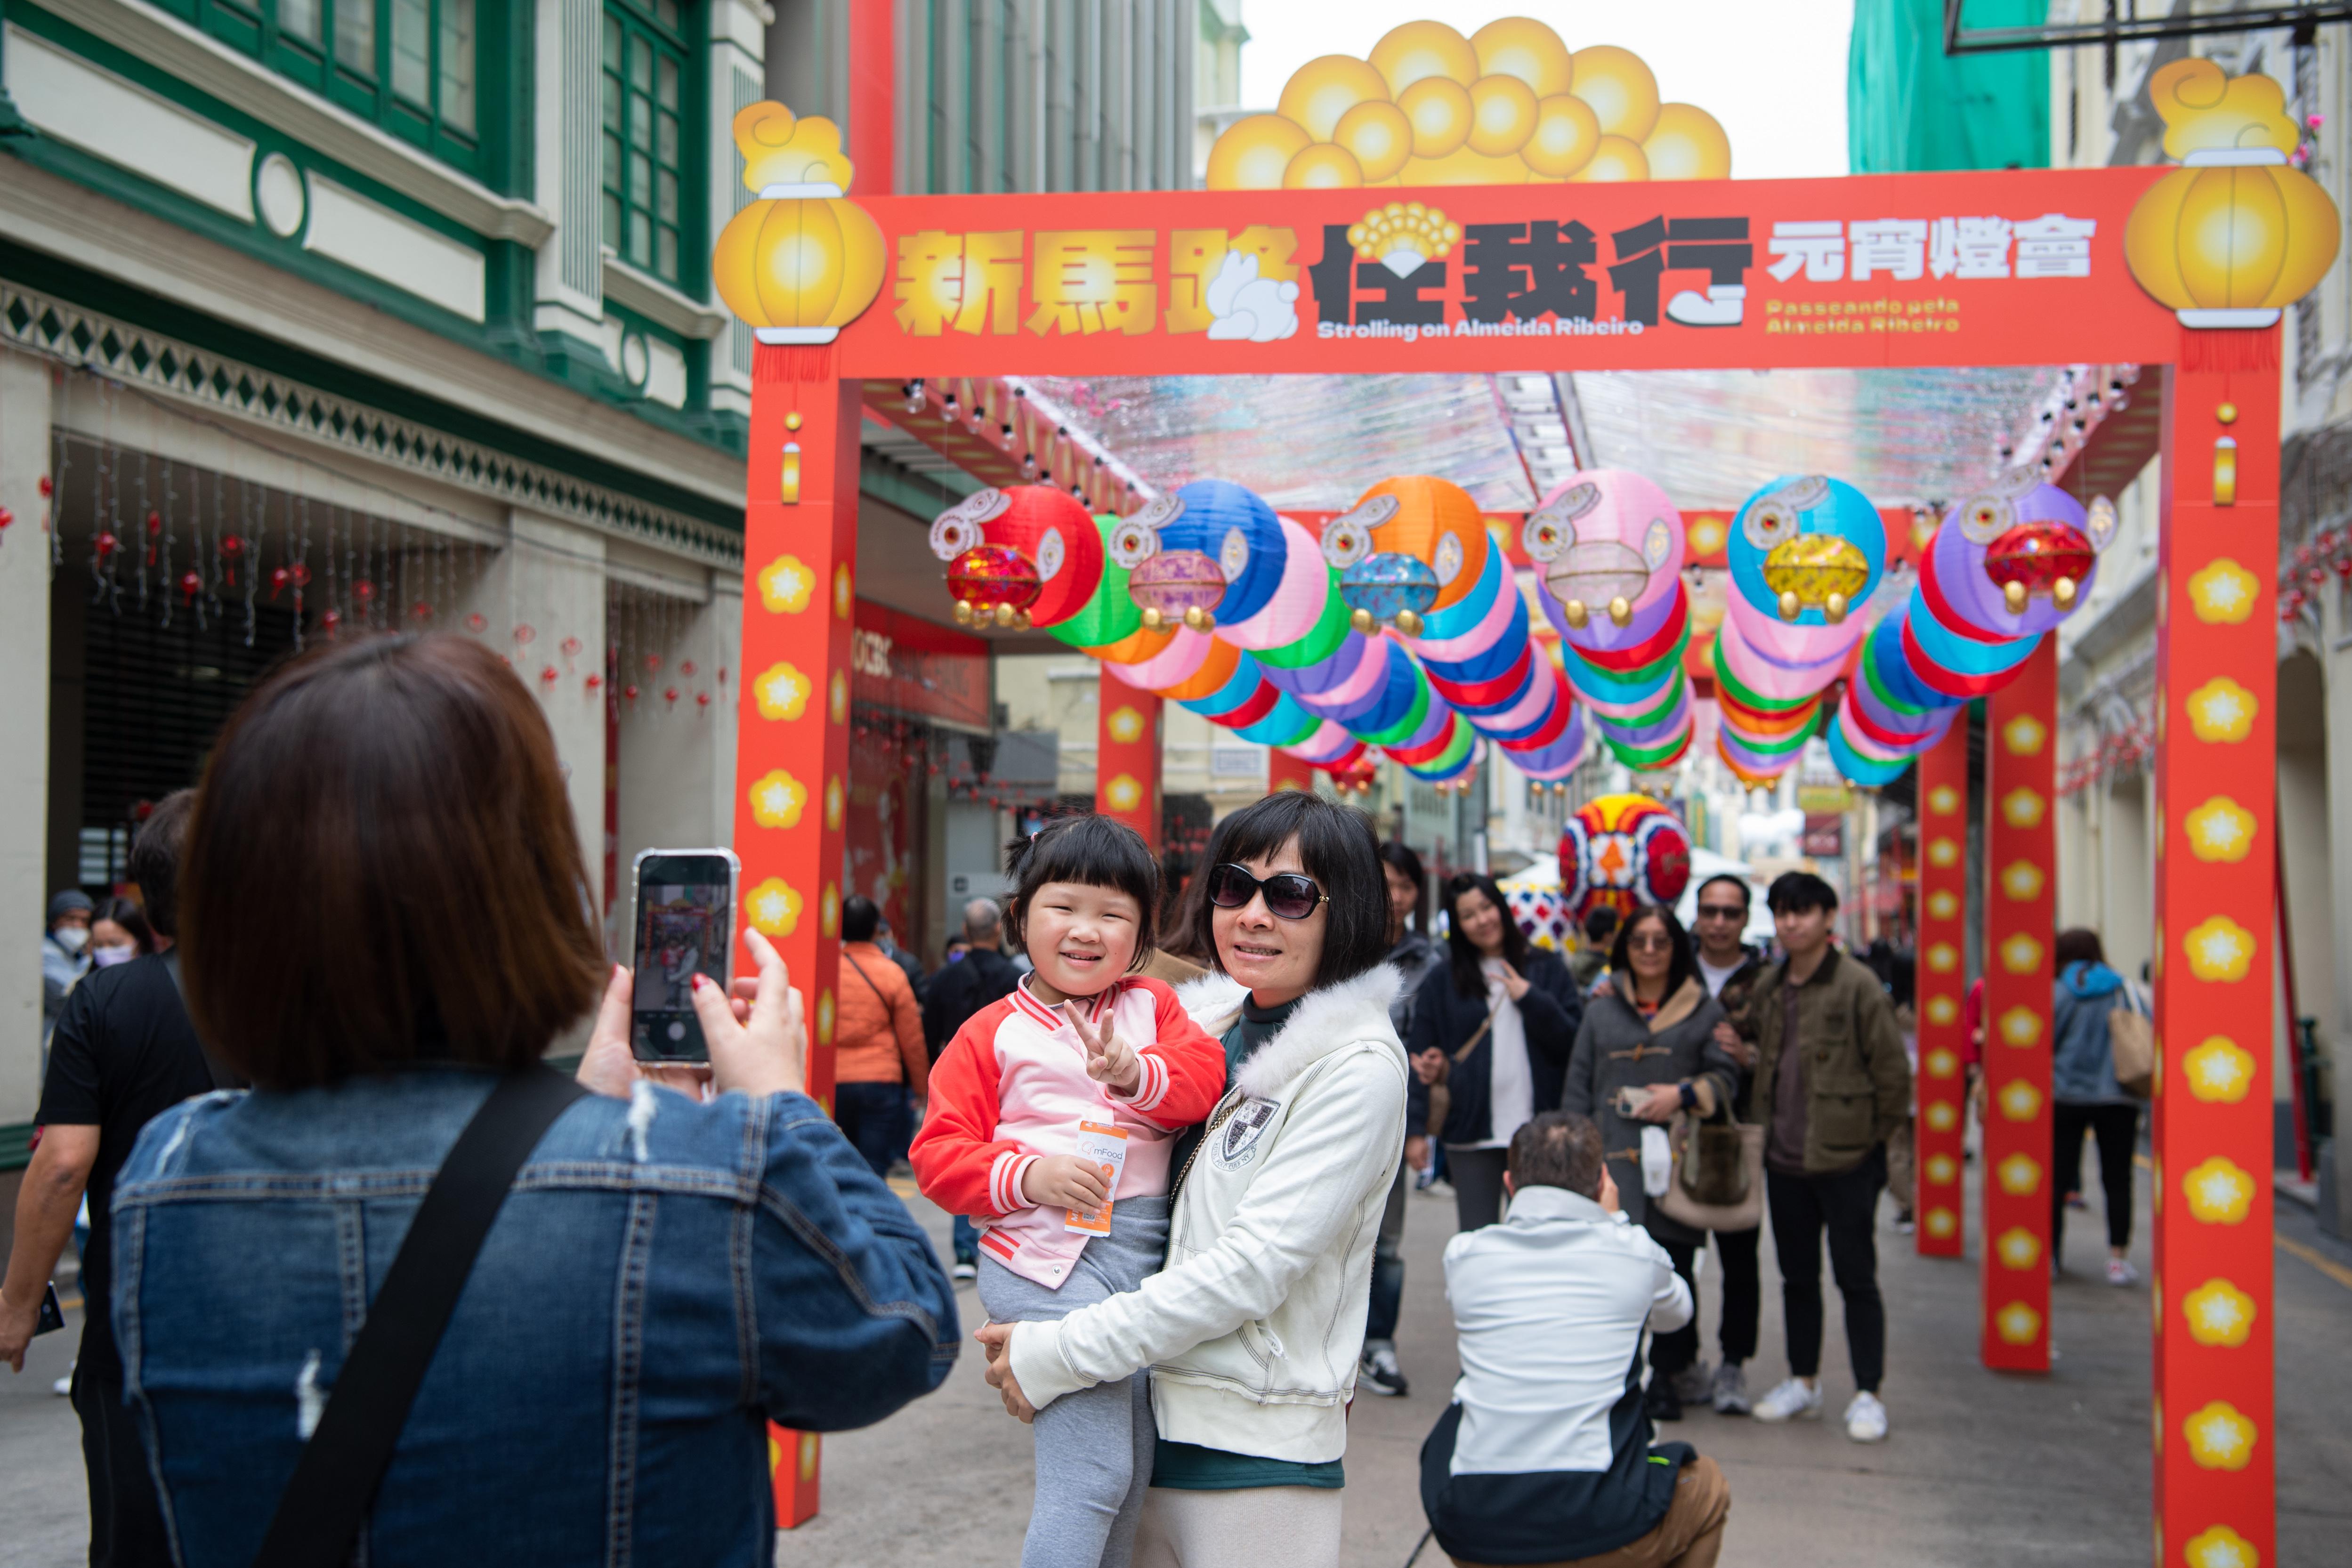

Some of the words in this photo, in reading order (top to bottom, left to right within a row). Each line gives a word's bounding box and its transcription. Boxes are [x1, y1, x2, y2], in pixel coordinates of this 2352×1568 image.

[1766, 213, 2097, 283] 元宵燈會
[1765, 296, 1903, 316] Passeando
[1906, 295, 1960, 317] pela
[1317, 318, 1418, 342] Strolling
[1421, 323, 1450, 337] on
[1453, 317, 1552, 338] Almeida
[1554, 315, 1644, 336] Ribeiro
[1765, 316, 1866, 335] Almeida
[1868, 315, 1960, 333] Ribeiro
[1094, 1148, 1123, 1160] mFood
